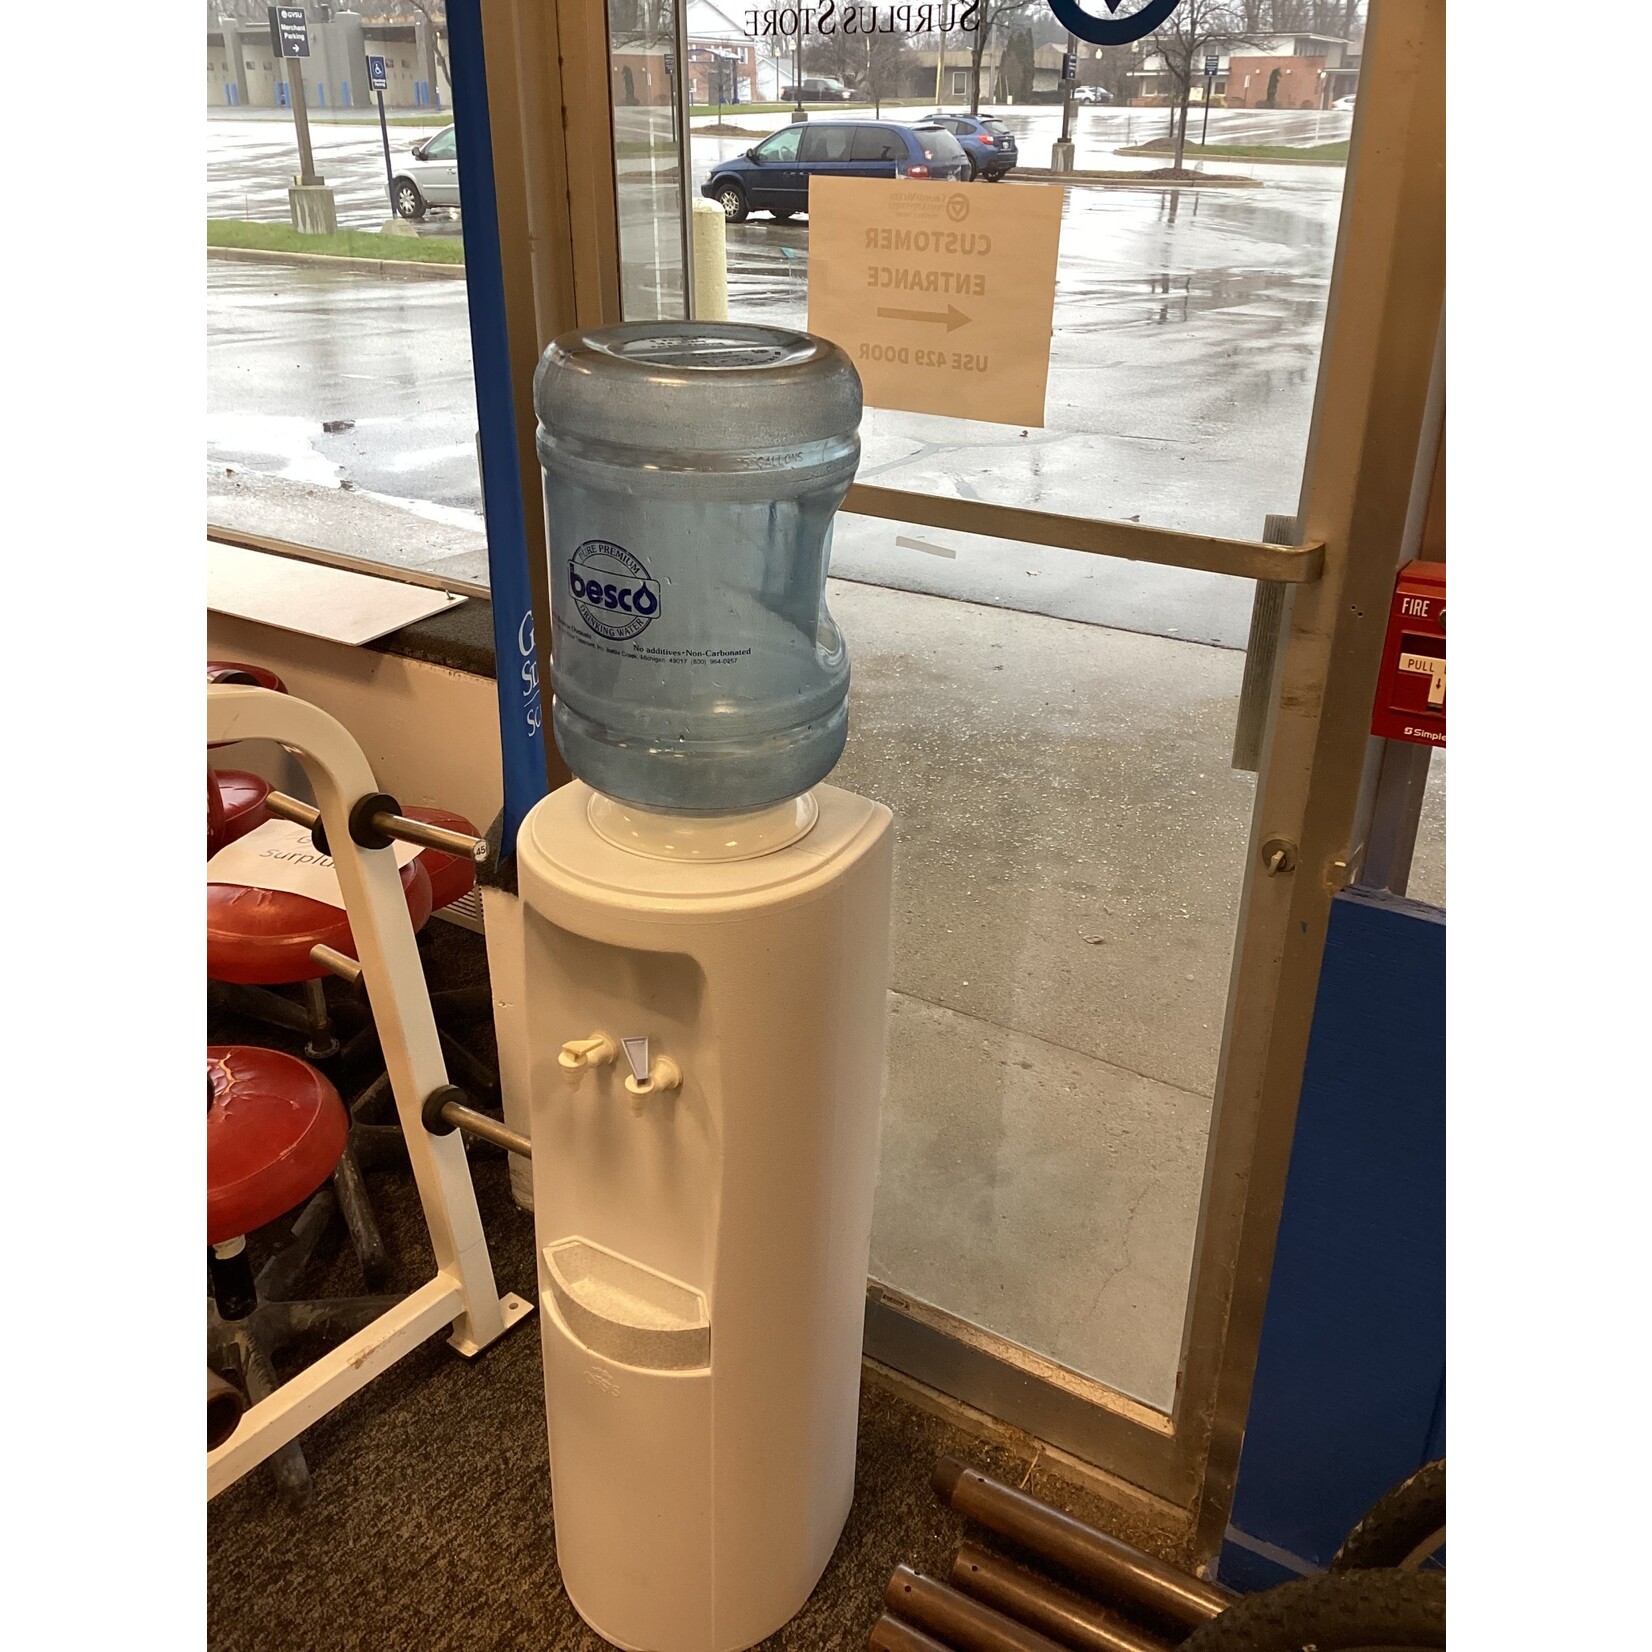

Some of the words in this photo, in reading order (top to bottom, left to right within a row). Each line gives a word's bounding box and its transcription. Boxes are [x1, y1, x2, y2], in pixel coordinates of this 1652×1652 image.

[280, 23, 306, 31] Merchant
[284, 32, 305, 41] Parking
[578, 544, 597, 561] PURE
[598, 544, 641, 574] PREMIUM
[569, 563, 658, 616] besco
[1402, 598, 1430, 617] FIRE
[580, 604, 615, 637] DRINKING
[617, 618, 644, 637] WATER
[633, 644, 644, 653] No
[1408, 658, 1434, 673] PULL
[259, 848, 336, 869] surplu
